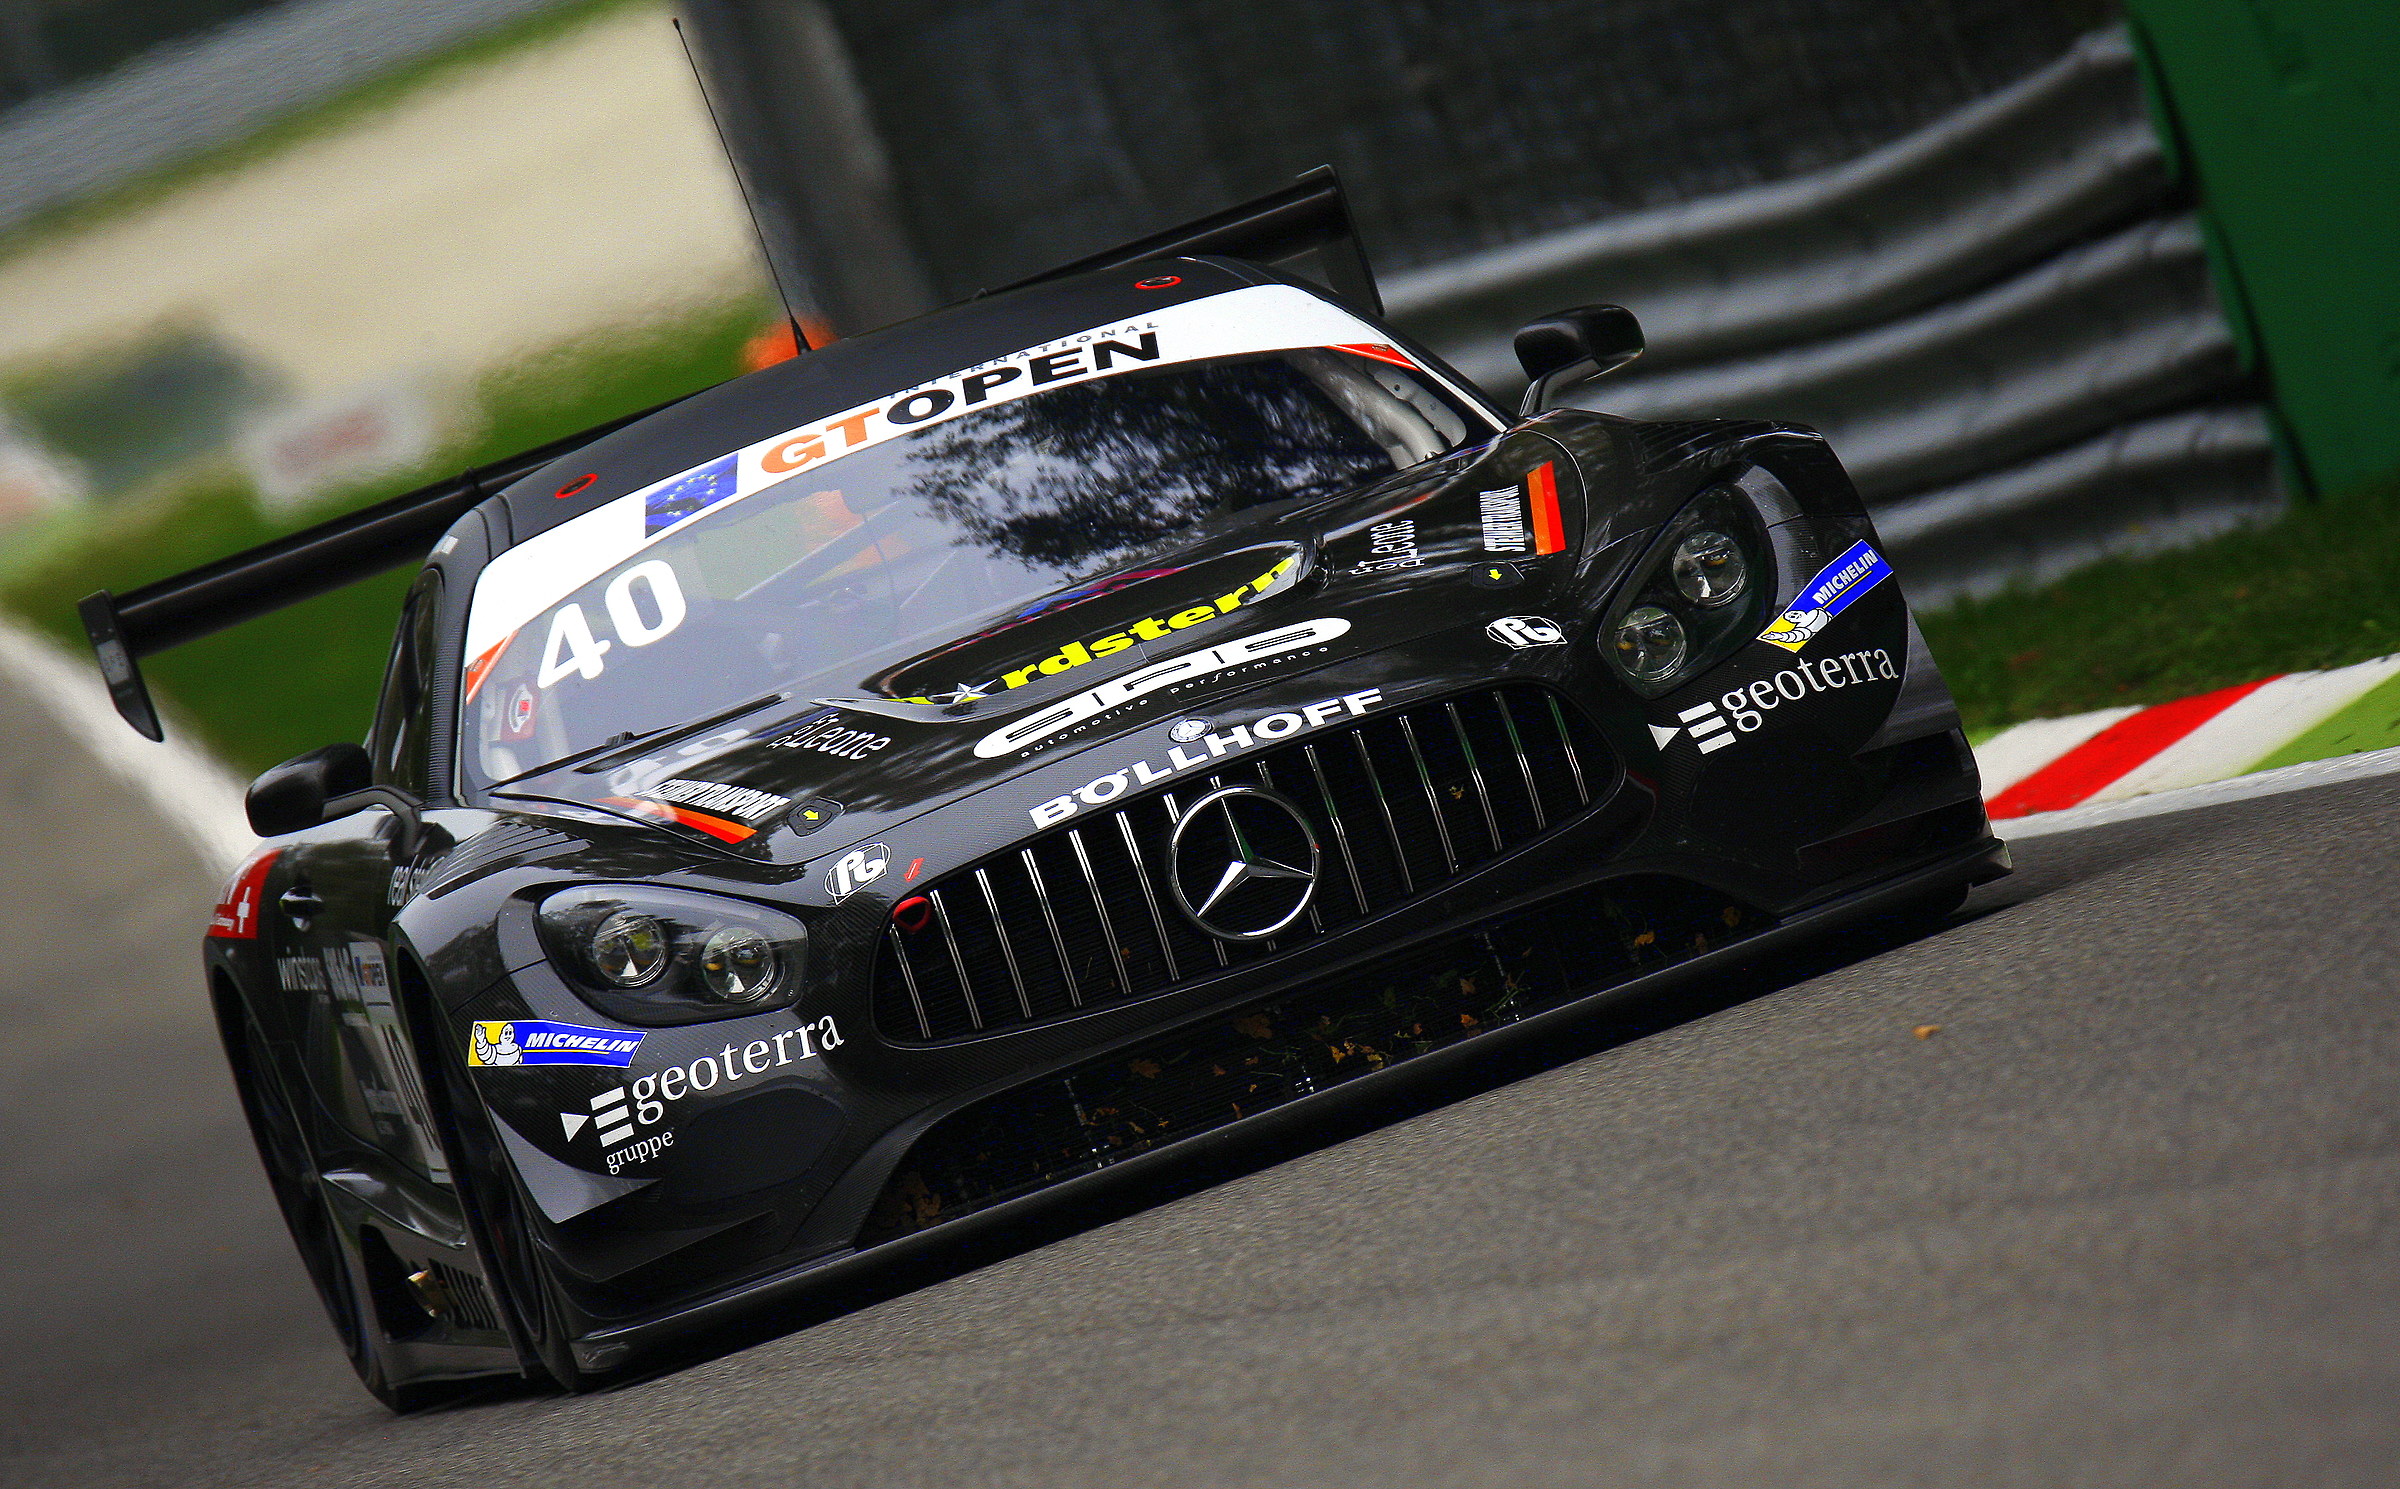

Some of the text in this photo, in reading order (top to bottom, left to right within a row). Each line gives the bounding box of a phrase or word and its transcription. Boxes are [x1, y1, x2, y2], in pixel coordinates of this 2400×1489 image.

[1812, 549, 1879, 605] MICHELIN
[537, 559, 687, 689] 40
[1020, 699, 1148, 758] automotive
[1169, 646, 1329, 694] performance
[1721, 648, 1900, 732] geoterra
[525, 1032, 640, 1053] MICHELIN
[631, 1015, 845, 1125] geoterra
[605, 1130, 675, 1175] gruppe
